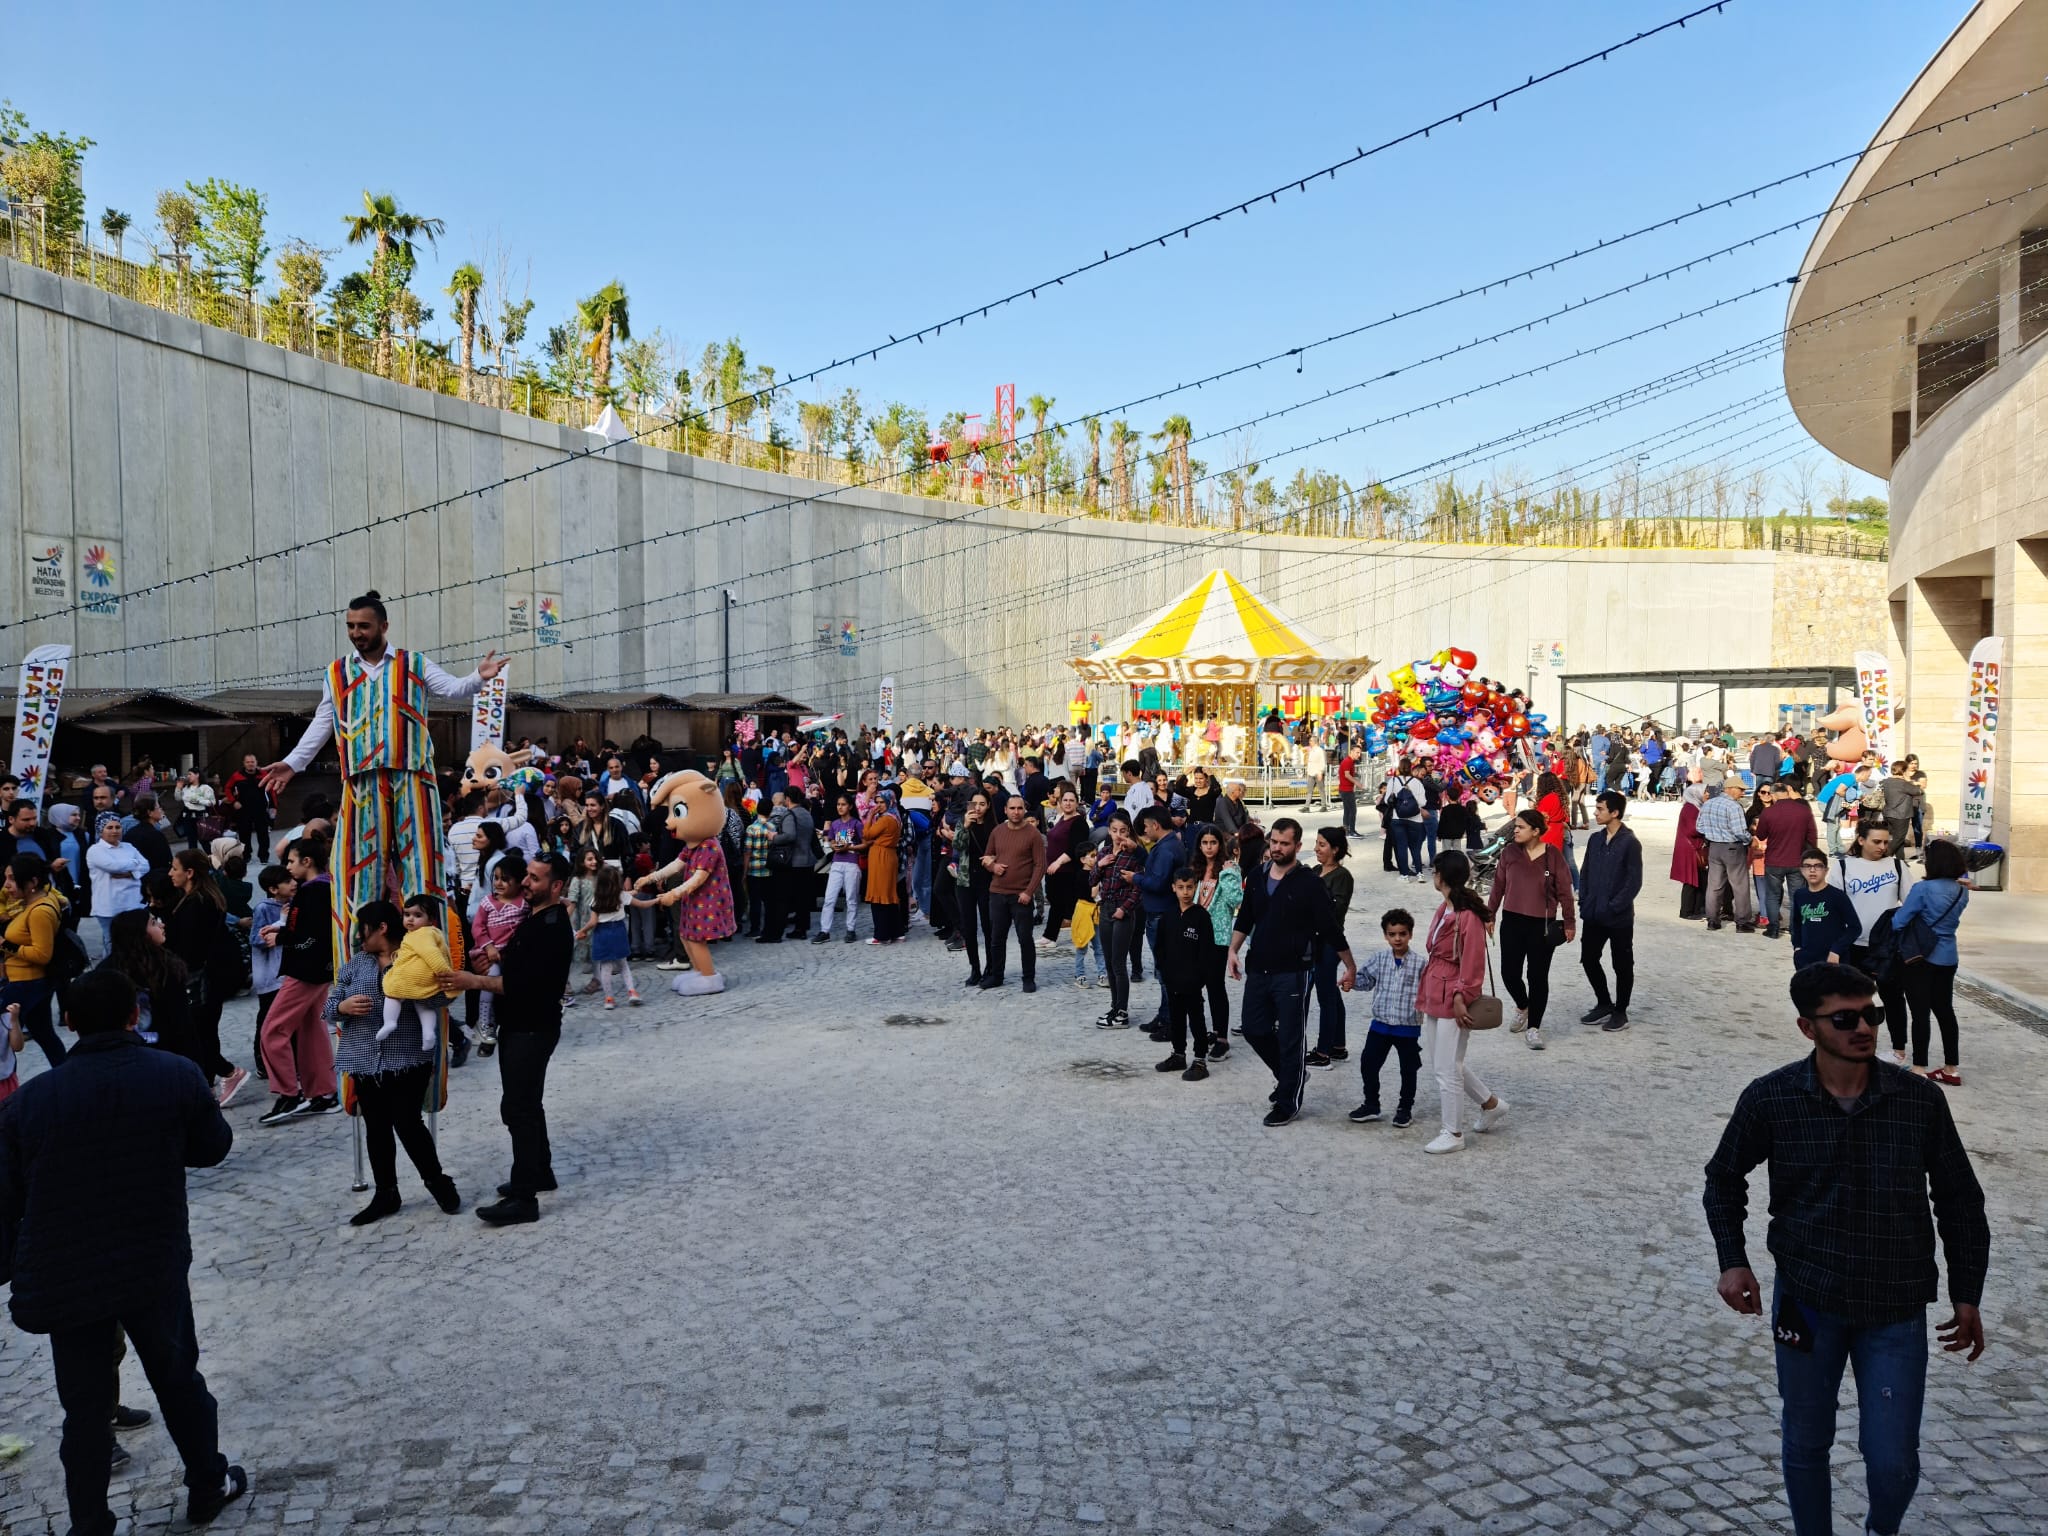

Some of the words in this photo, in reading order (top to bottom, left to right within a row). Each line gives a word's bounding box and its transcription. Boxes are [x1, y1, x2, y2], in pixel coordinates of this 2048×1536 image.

[36, 566, 62, 578] HATAY
[21, 665, 44, 742] HATAY
[489, 678, 505, 739] EXPO'21
[1874, 668, 1890, 734] HATAY
[1968, 661, 1985, 743] HATAY
[1849, 869, 1898, 896] Dodgers
